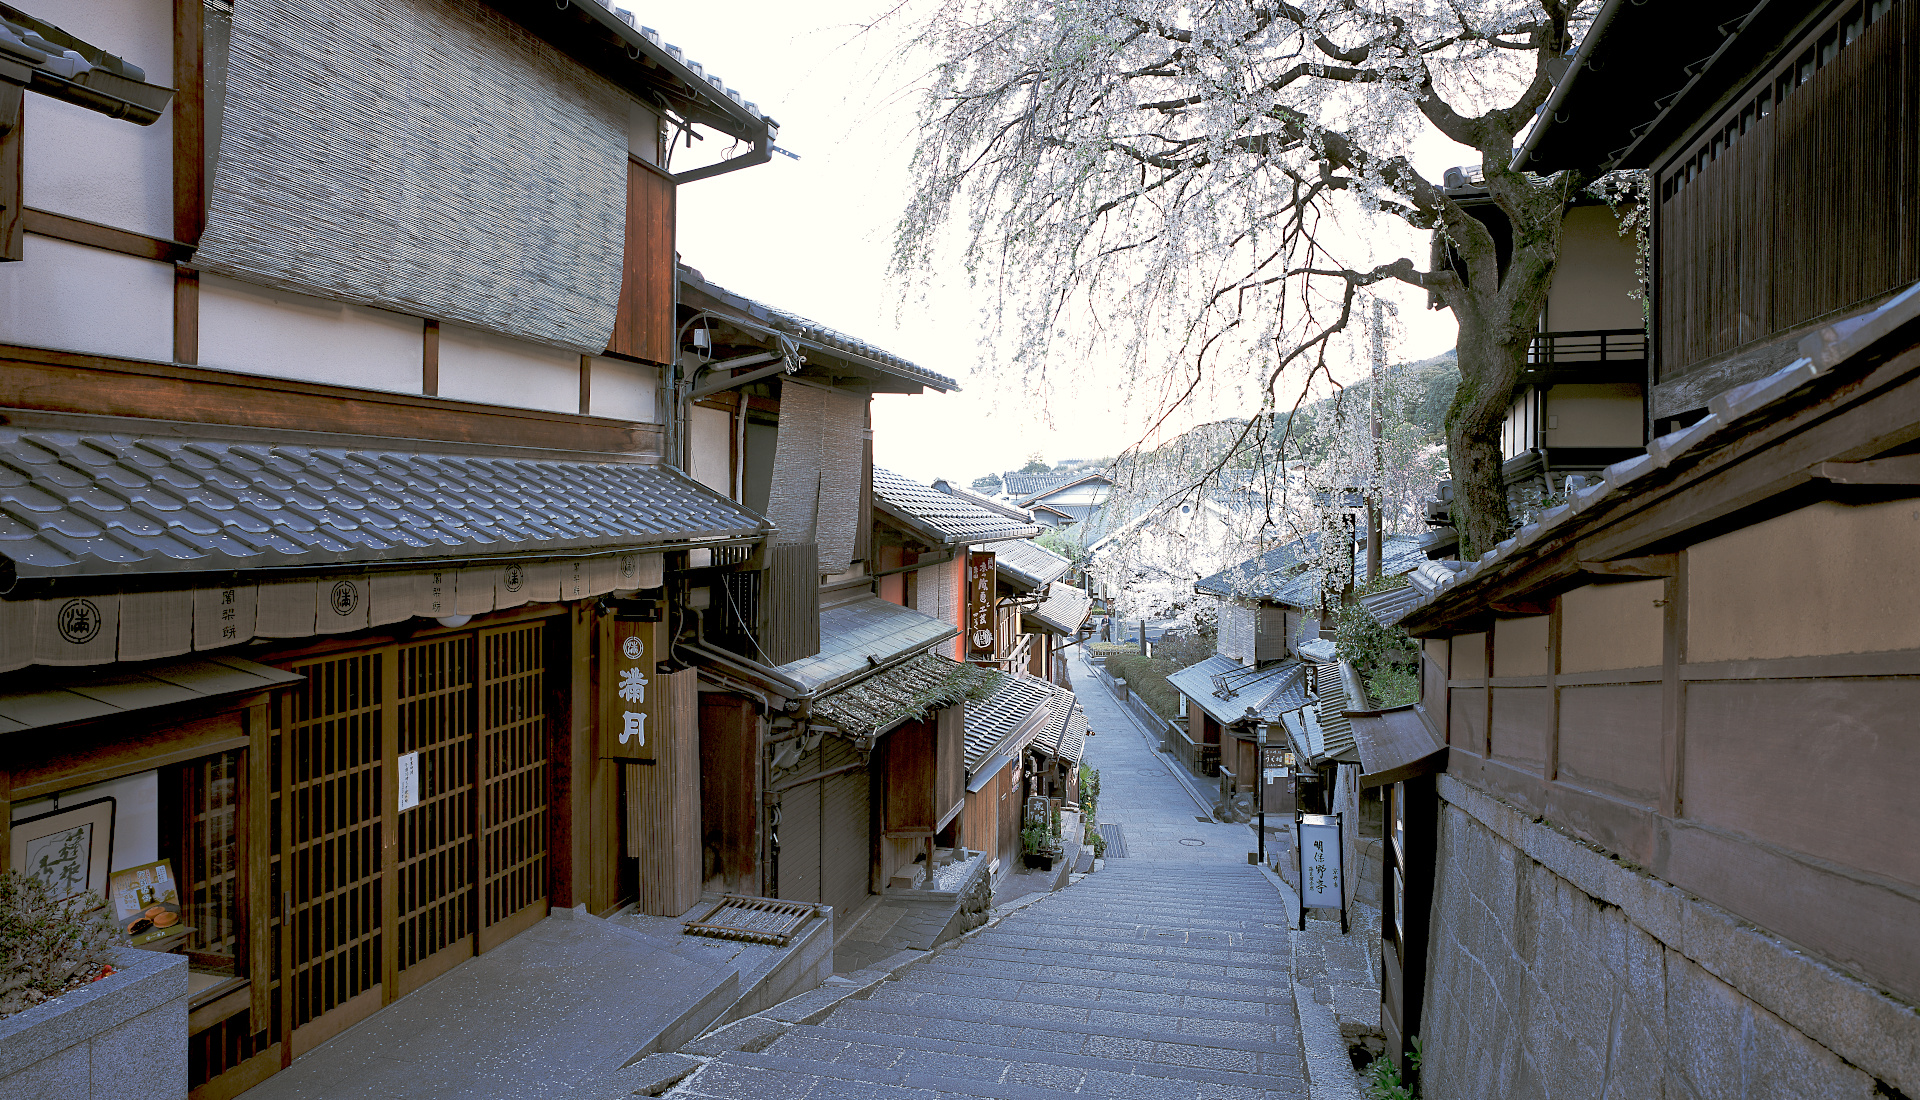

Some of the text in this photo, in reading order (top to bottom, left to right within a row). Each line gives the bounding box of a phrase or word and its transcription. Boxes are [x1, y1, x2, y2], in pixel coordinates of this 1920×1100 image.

[222, 590, 236, 639] 闍梨餅
[619, 667, 648, 747] 満月
[1314, 840, 1327, 894] 明保野亭
